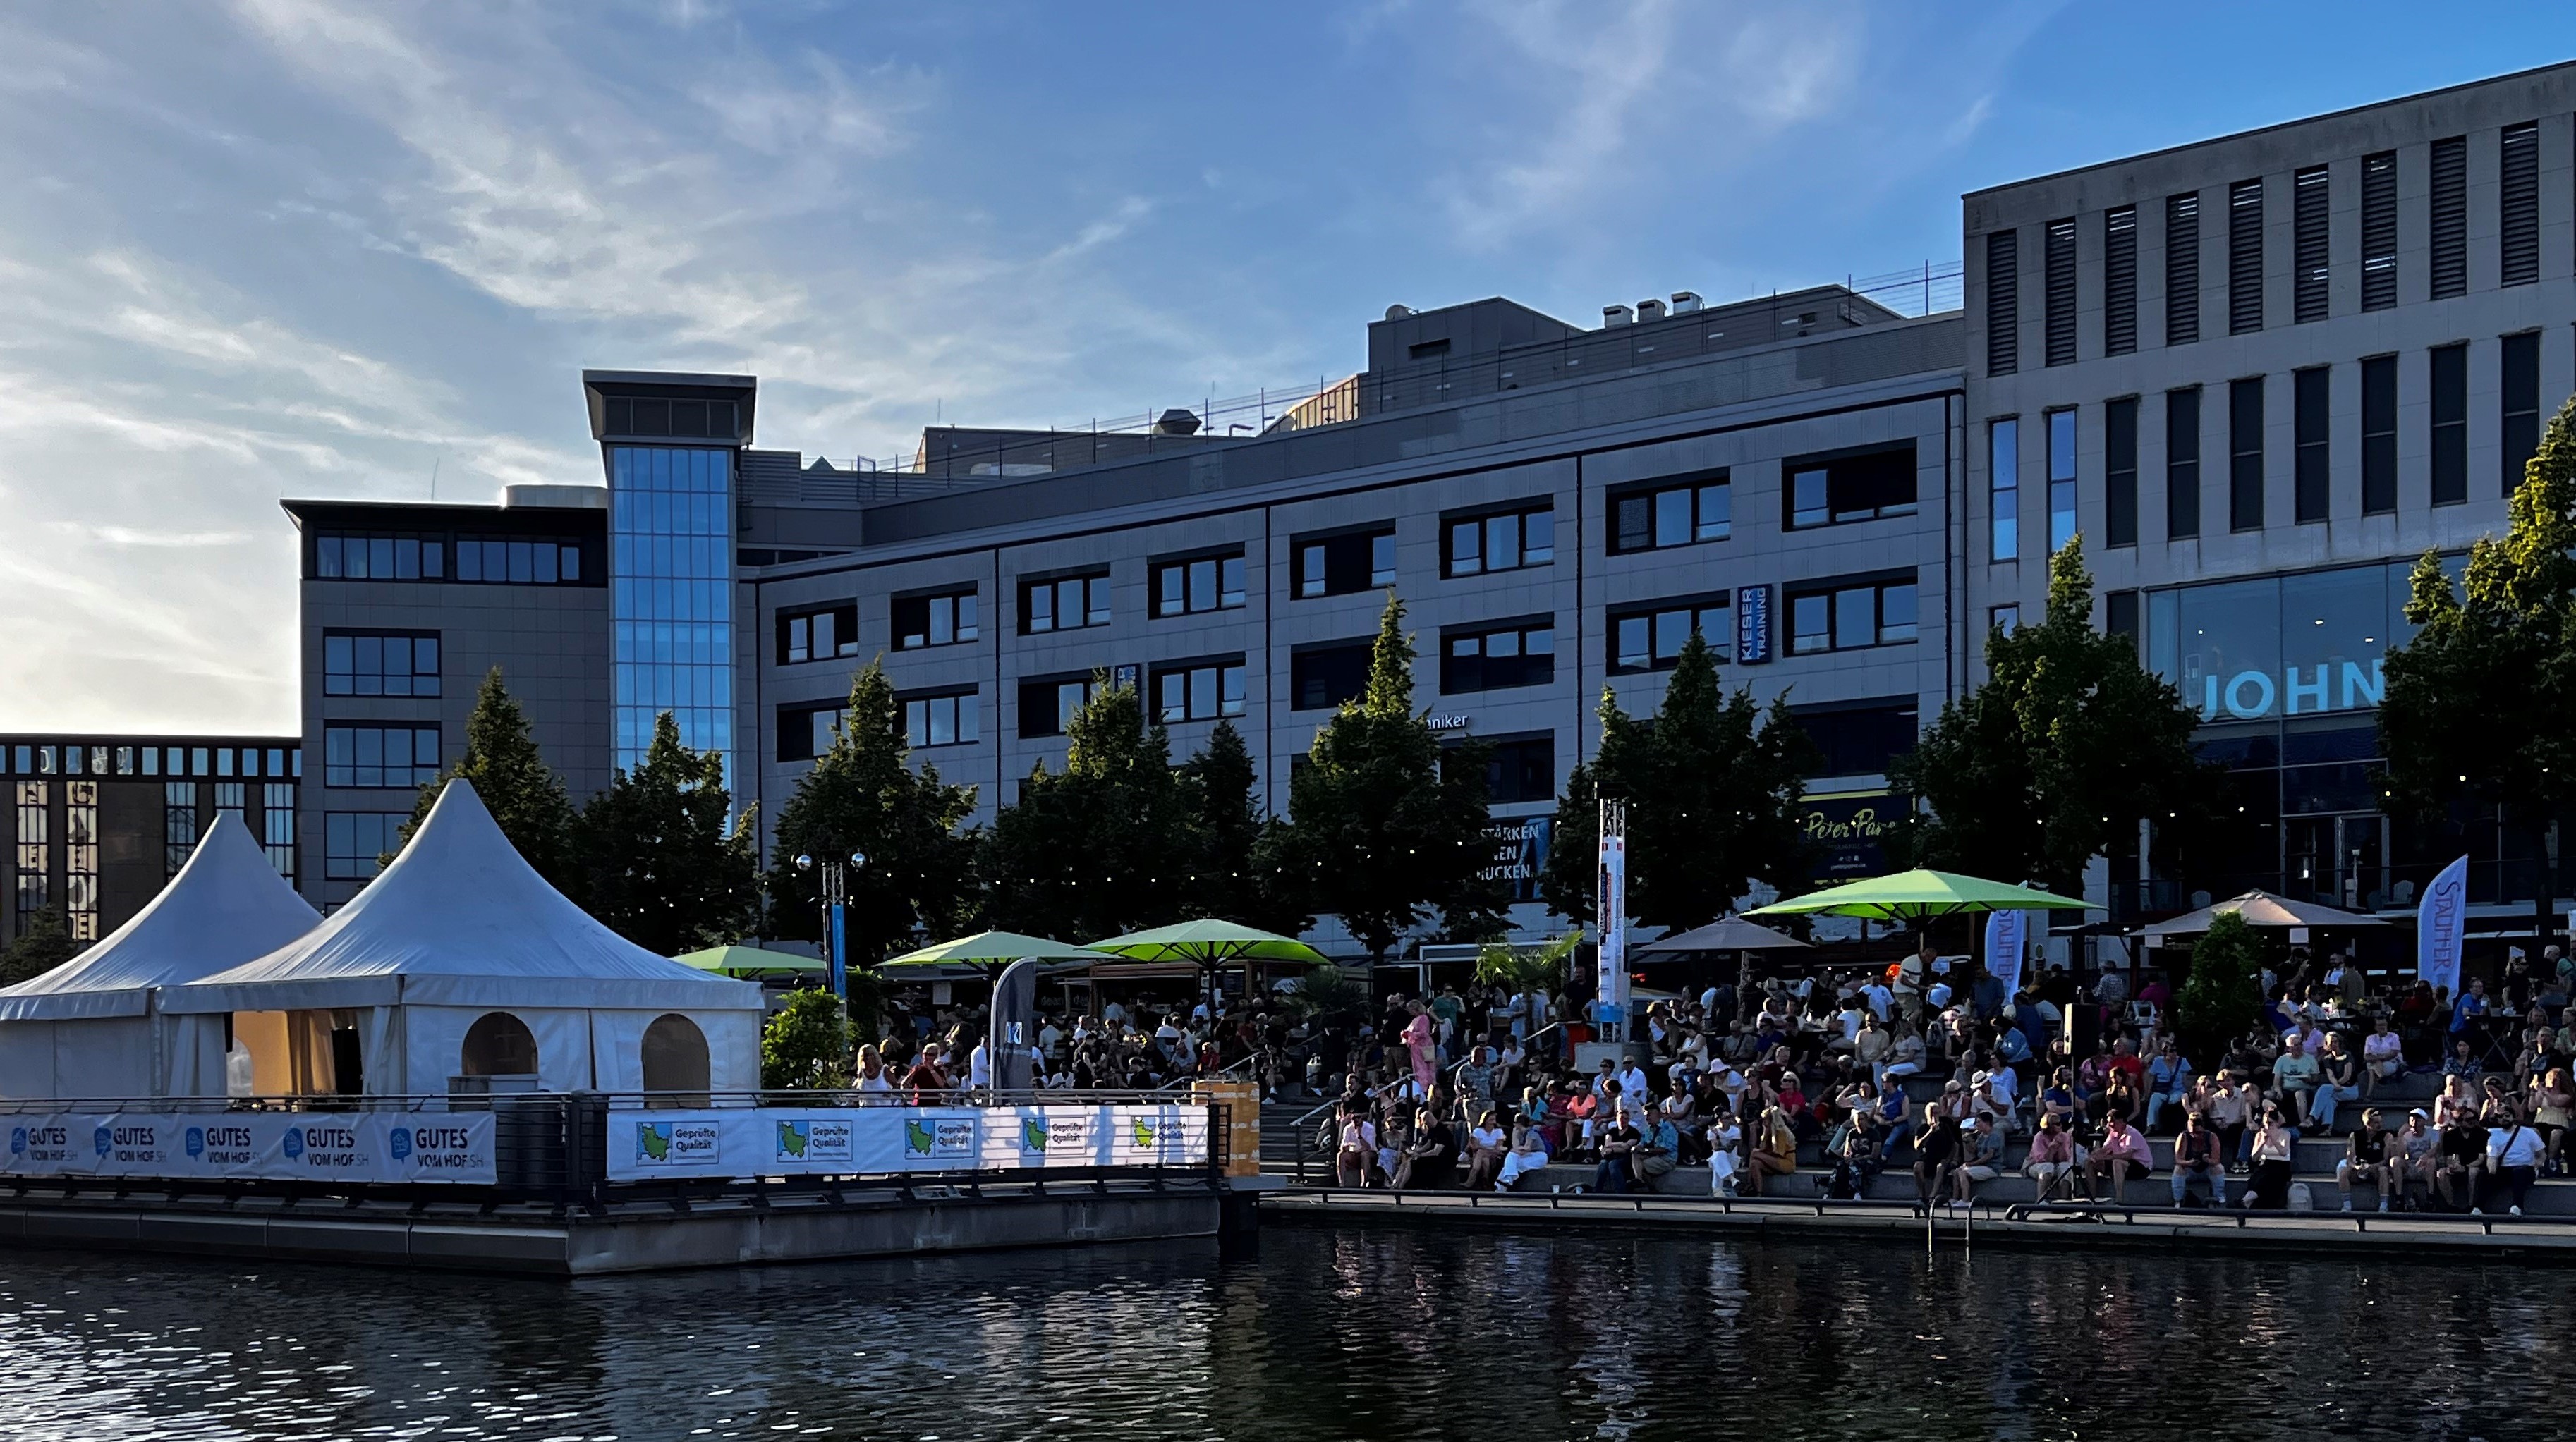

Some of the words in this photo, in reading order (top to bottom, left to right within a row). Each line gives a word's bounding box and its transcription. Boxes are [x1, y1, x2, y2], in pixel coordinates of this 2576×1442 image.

[1742, 589, 1753, 660] KIESER
[1757, 587, 1766, 659] TRAINING
[2199, 659, 2386, 723] JOHN
[1803, 812, 1850, 840] Peter
[1493, 846, 1517, 860] EN
[2434, 881, 2461, 972] STAUFFER
[29, 1128, 66, 1145] GUTES
[113, 1128, 154, 1146] GUTES
[206, 1128, 250, 1147] GUTES
[306, 1128, 355, 1149] GUTES
[416, 1128, 468, 1149] GUTES
[812, 1125, 849, 1137] Geprüfte
[114, 1150, 136, 1162] VOM
[207, 1151, 229, 1163] VOM
[308, 1153, 331, 1166] VOM
[417, 1154, 442, 1168] VOM
